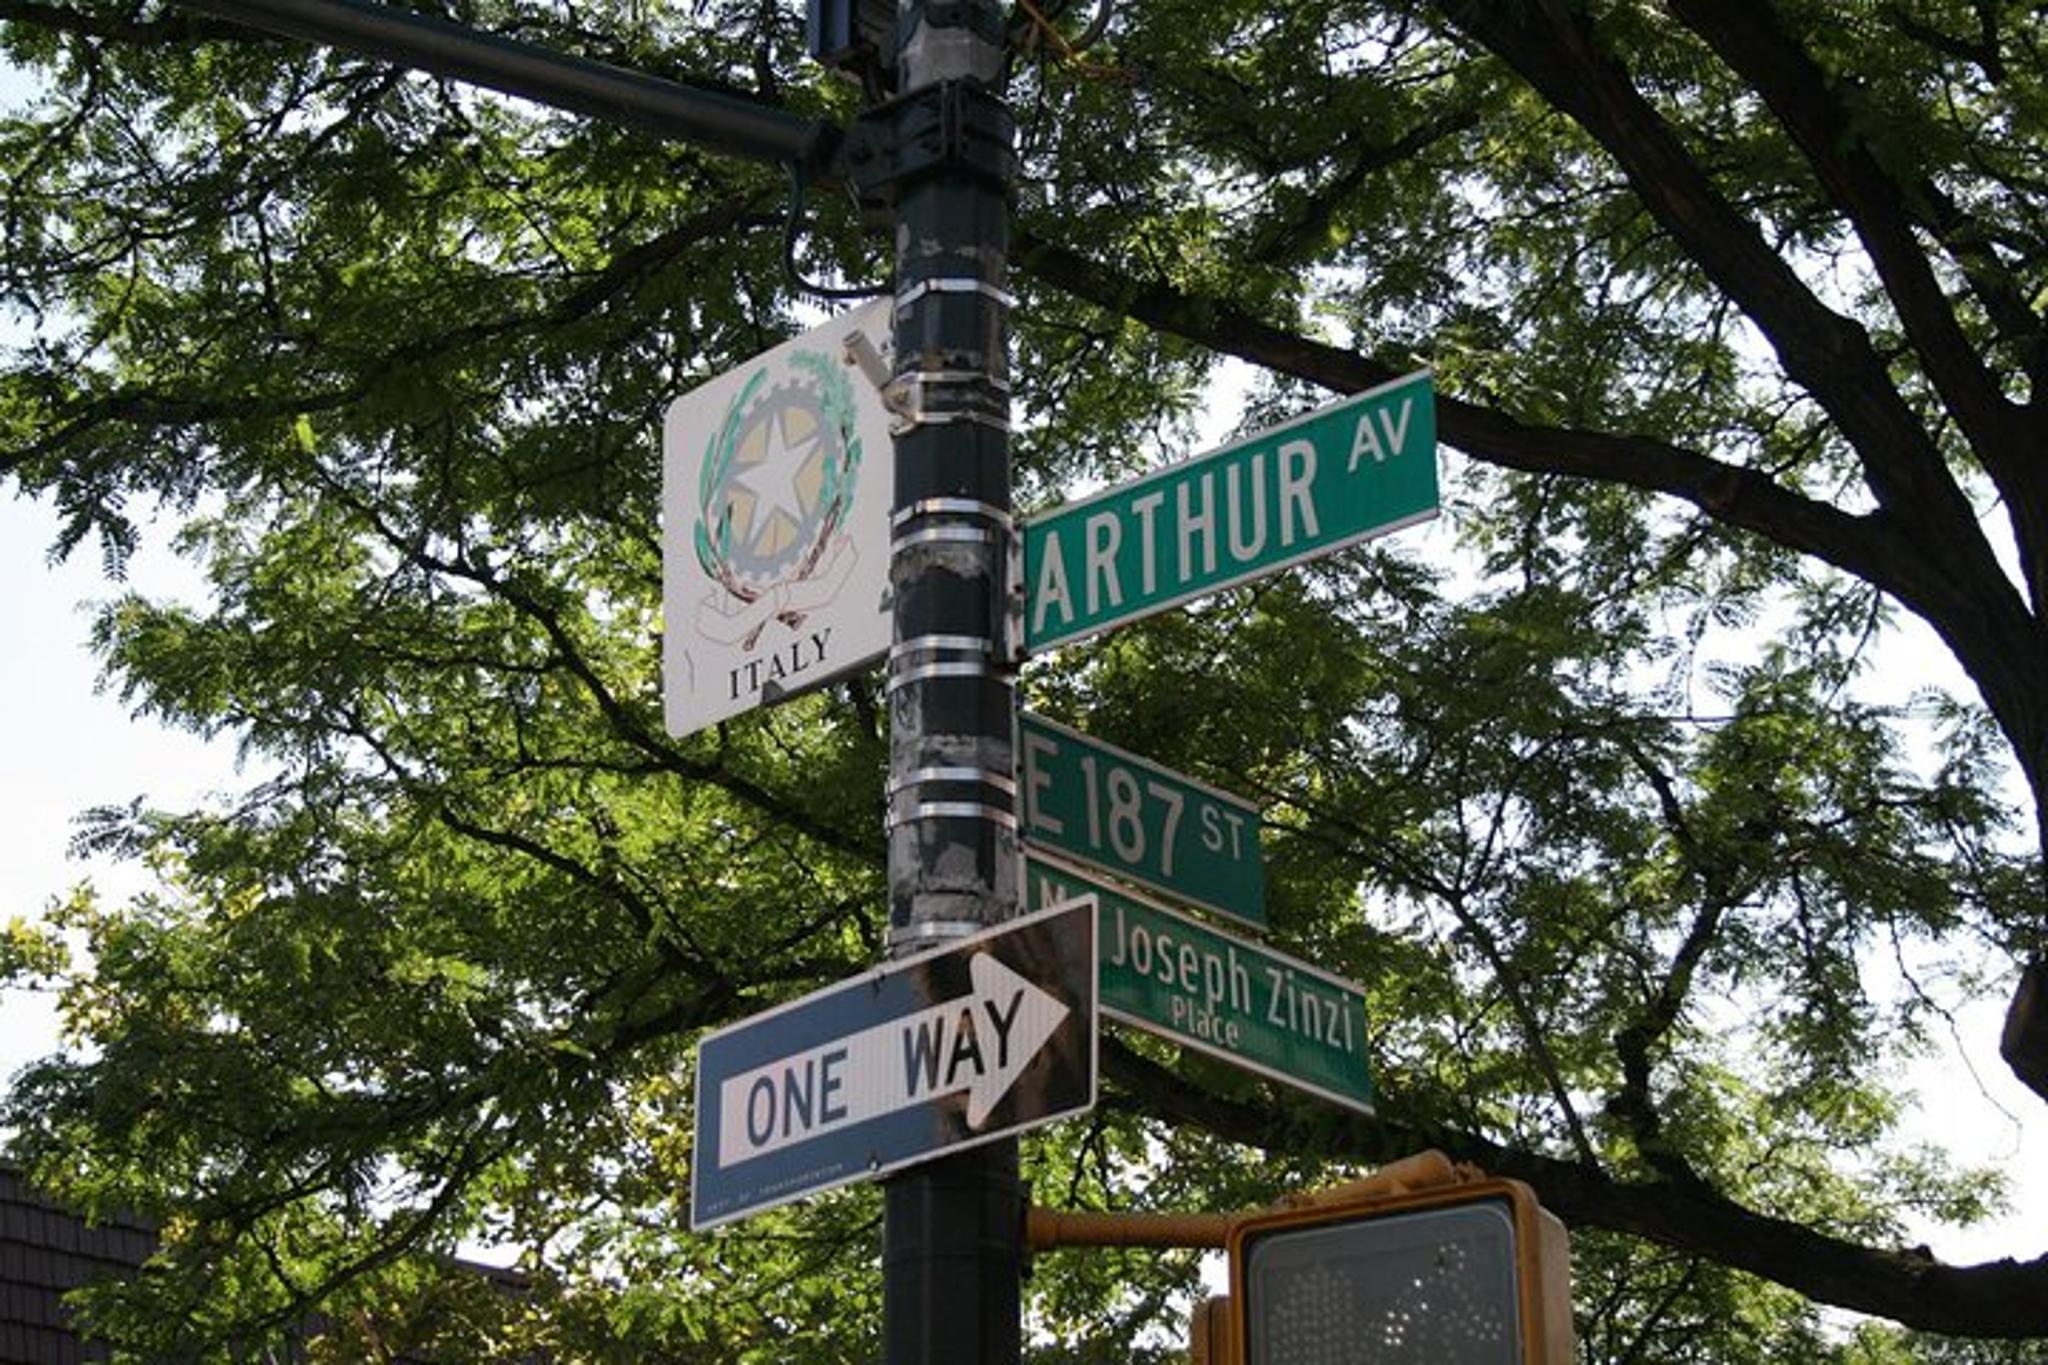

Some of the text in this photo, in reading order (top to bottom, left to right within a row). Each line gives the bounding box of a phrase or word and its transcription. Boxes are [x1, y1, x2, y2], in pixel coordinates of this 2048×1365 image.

[1032, 399, 1412, 634] ARTHUR AV
[730, 628, 832, 699] ITALY
[1024, 733, 1244, 877] E 187 ST
[1111, 908, 1354, 1053] Joseph Zinzi
[1171, 994, 1240, 1048] Place
[746, 989, 1025, 1148] ONE WAY
